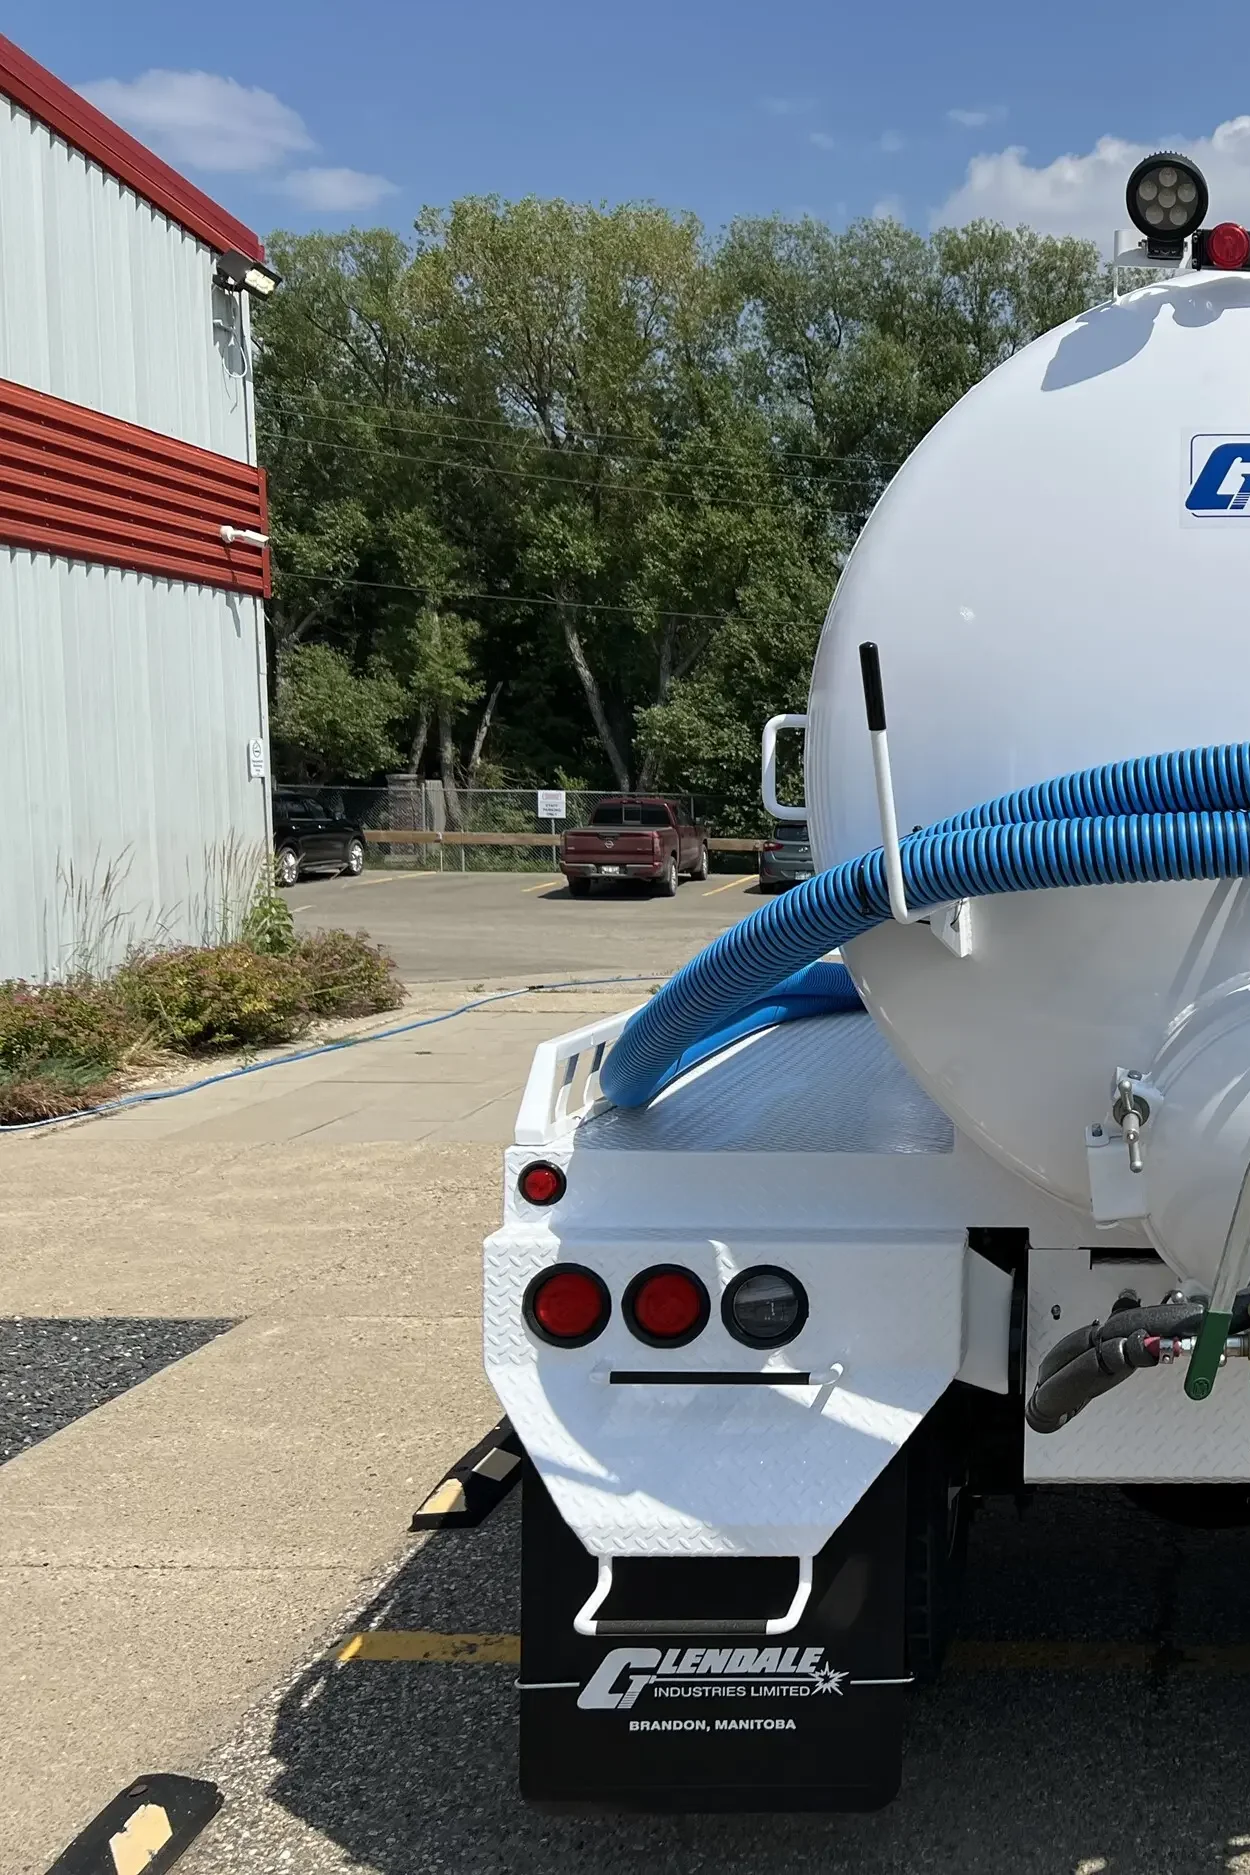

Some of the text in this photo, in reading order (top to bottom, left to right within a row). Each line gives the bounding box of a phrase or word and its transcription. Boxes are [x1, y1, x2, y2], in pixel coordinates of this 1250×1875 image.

[577, 1647, 825, 1709] GLENDALE
[654, 1686, 811, 1698] INDUSTRIES LIMITED
[629, 1719, 796, 1732] BRANDON, MANITOBA
